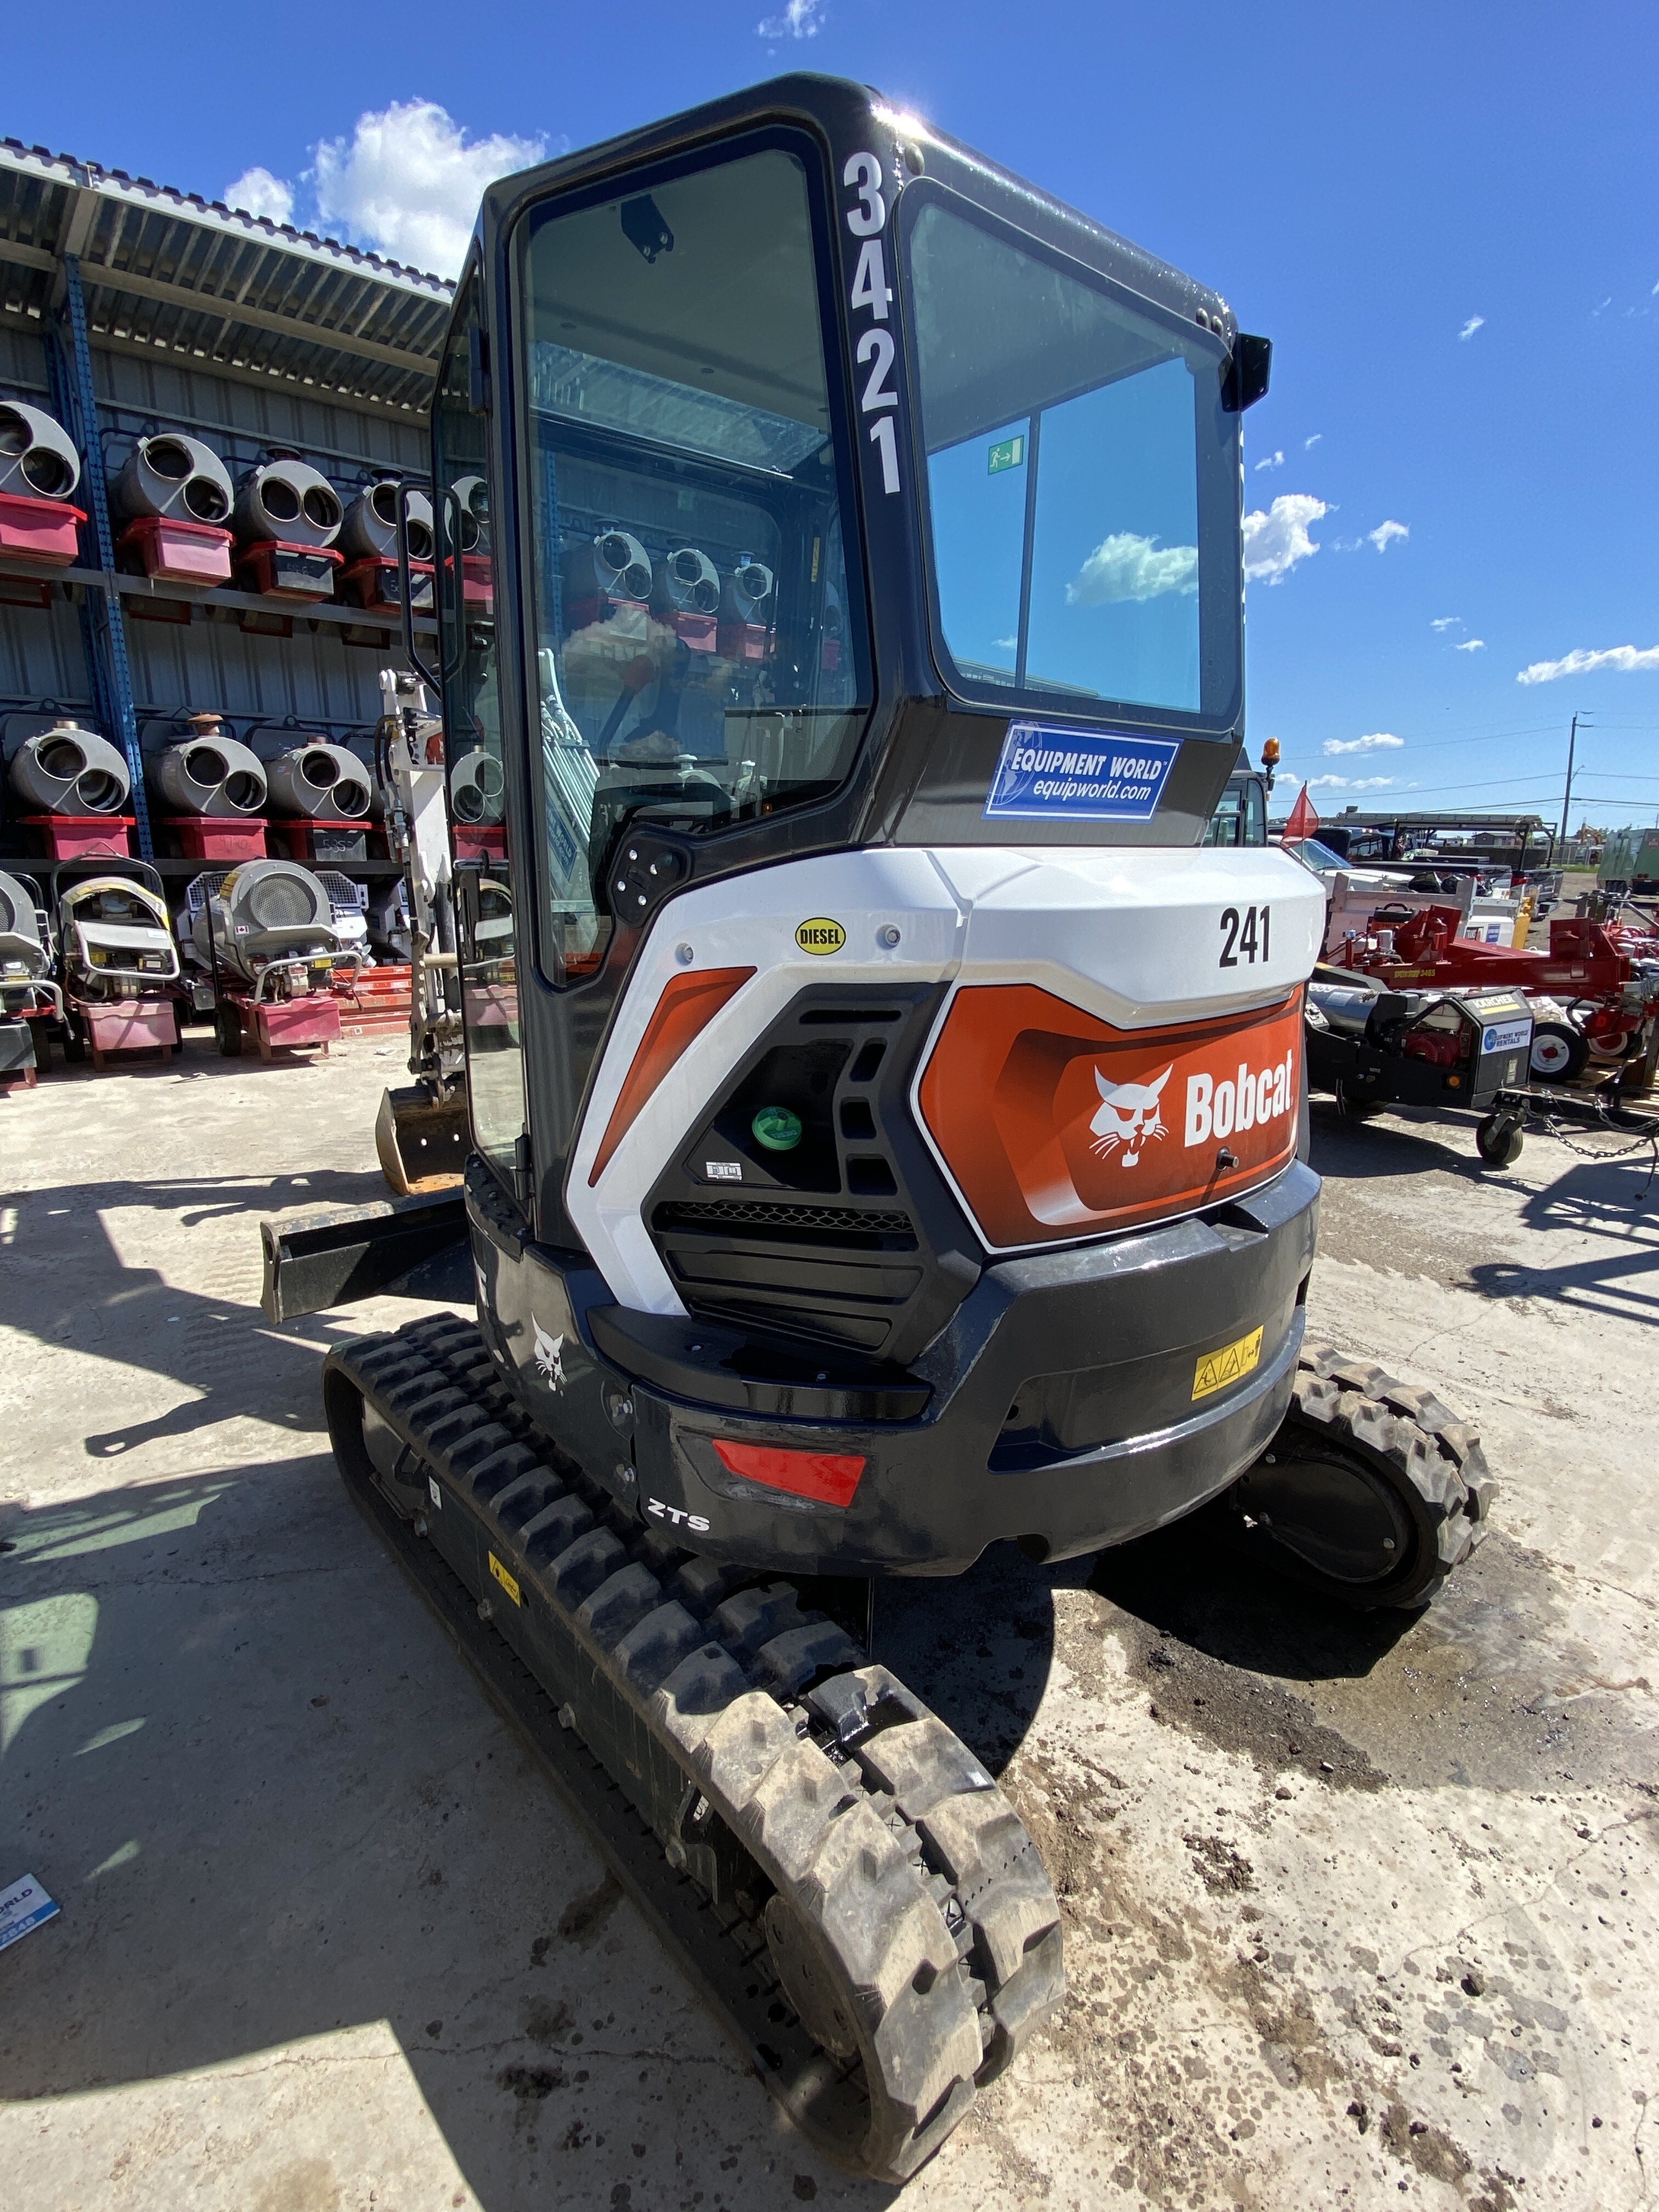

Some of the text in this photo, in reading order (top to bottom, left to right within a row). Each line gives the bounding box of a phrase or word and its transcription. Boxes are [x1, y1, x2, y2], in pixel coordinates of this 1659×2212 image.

[843, 151, 900, 494] 3421
[1011, 748, 1162, 780] EQUIPMENT WORLD
[1033, 777, 1152, 802] equipworld.com
[800, 928, 840, 945] DIESEL
[1219, 905, 1271, 968] 241
[1496, 1037, 1520, 1047] RENTALS
[1184, 1048, 1293, 1148] Bobcat
[647, 1498, 710, 1532] ZTS
